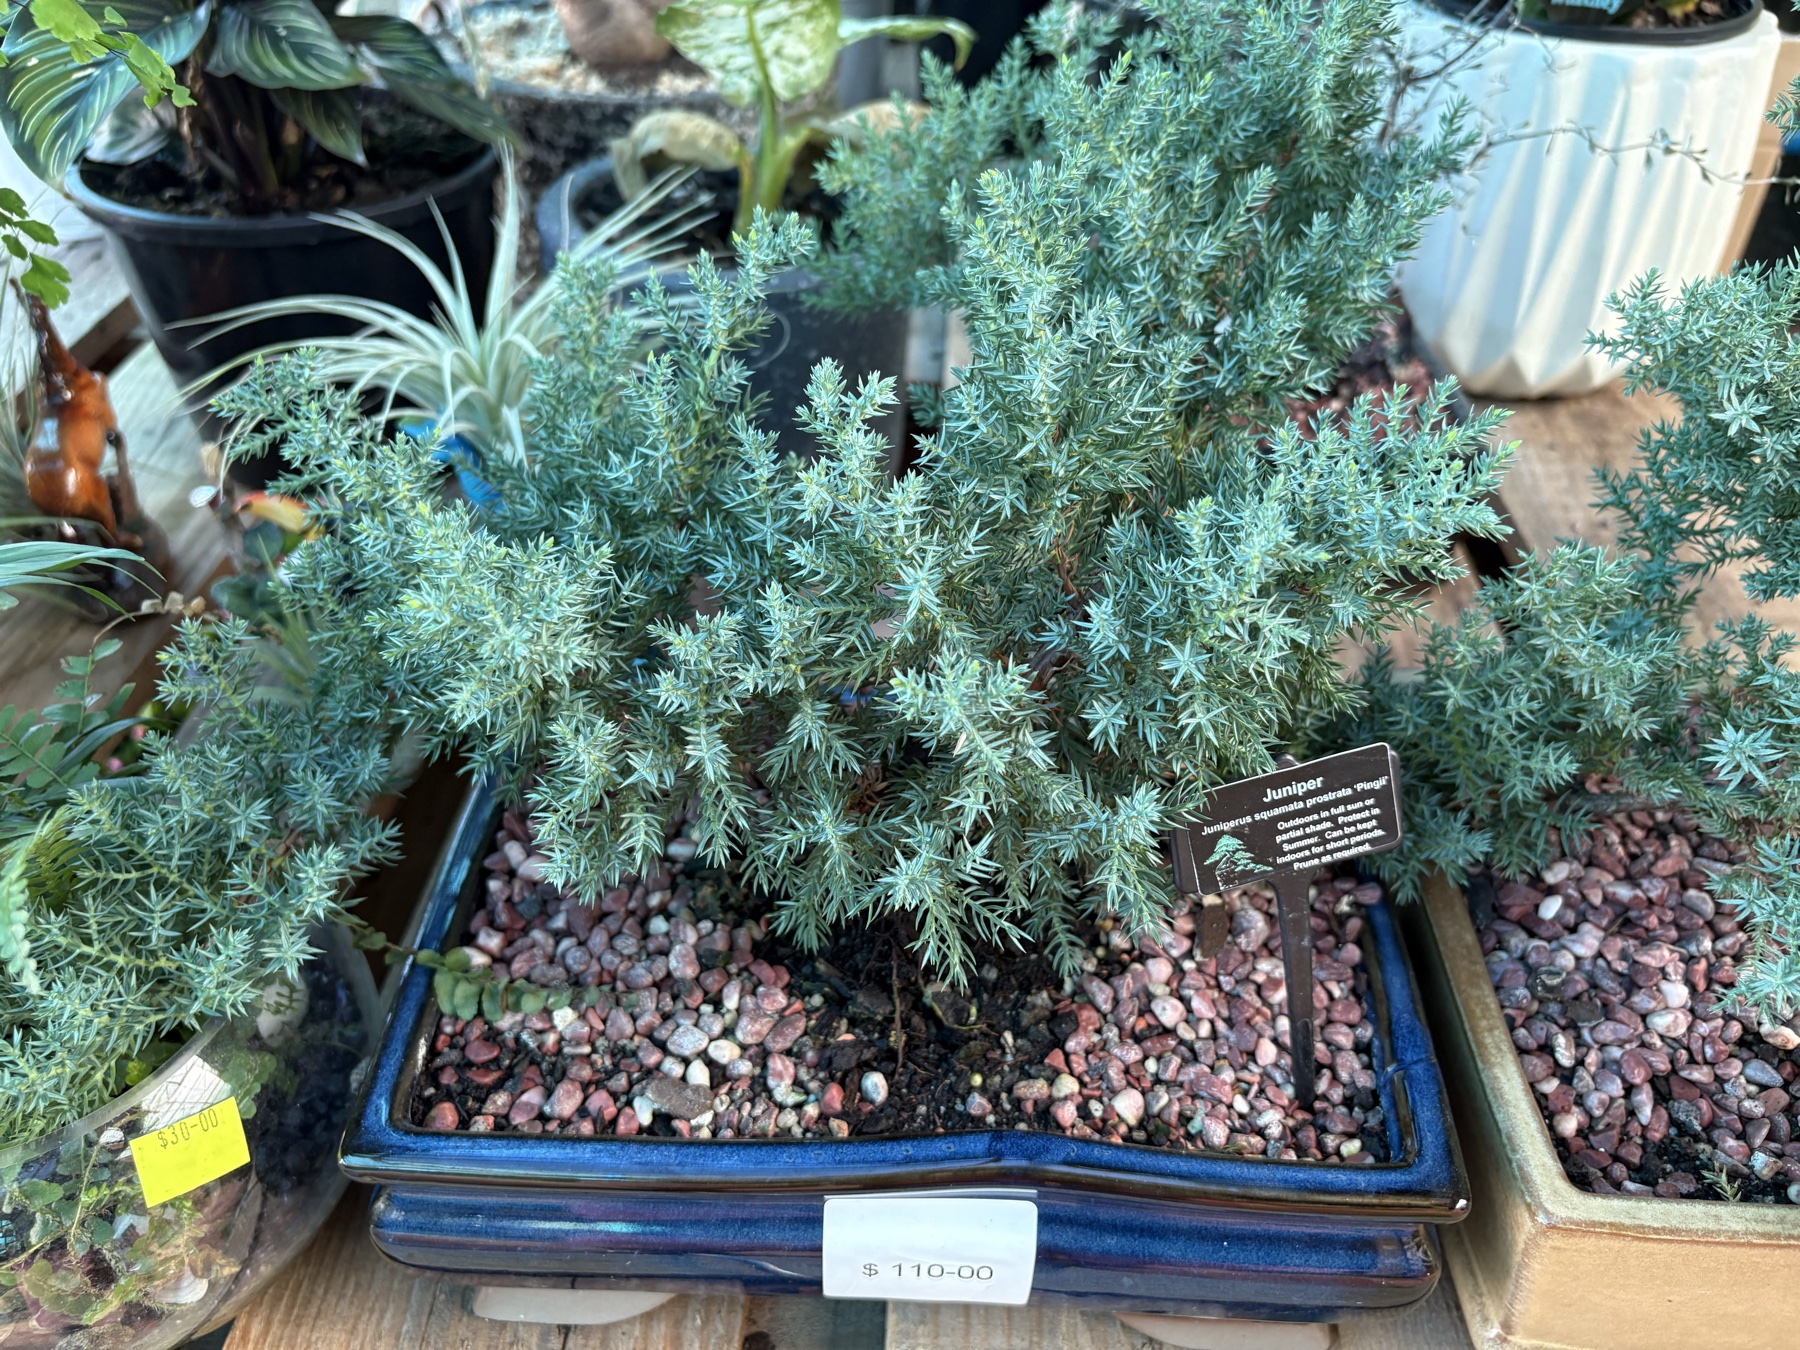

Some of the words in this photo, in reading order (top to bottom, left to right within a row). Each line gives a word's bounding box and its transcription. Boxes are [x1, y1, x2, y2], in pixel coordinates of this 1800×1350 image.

[1262, 777, 1324, 803] Juniper
[1201, 815, 1252, 836] Juniperus
[1254, 801, 1304, 821] squamata
[1306, 787, 1352, 808] prostrata
[1276, 827, 1304, 843] partial
[1305, 821, 1334, 834] shade.
[1338, 810, 1369, 824] Protect
[1371, 807, 1381, 816] in
[1277, 813, 1319, 830] Outdoors
[1320, 810, 1329, 818] in
[1330, 805, 1345, 816] full
[1347, 801, 1363, 811] sun
[1364, 798, 1375, 806] or
[1276, 848, 1310, 864] indoors
[1311, 845, 1325, 854] for
[1326, 838, 1351, 850] short
[1350, 829, 1386, 845] periods.
[1282, 836, 1321, 851] Summer.
[1325, 830, 1343, 839] Can
[1344, 825, 1356, 834] be
[1357, 819, 1377, 831] kept
[1293, 857, 1319, 871] Prune
[1321, 854, 1332, 862] as
[1332, 842, 1372, 860] required.
[157, 1108, 219, 1149] $30-00
[862, 1262, 878, 1277] $
[892, 1262, 993, 1281] 110-00
